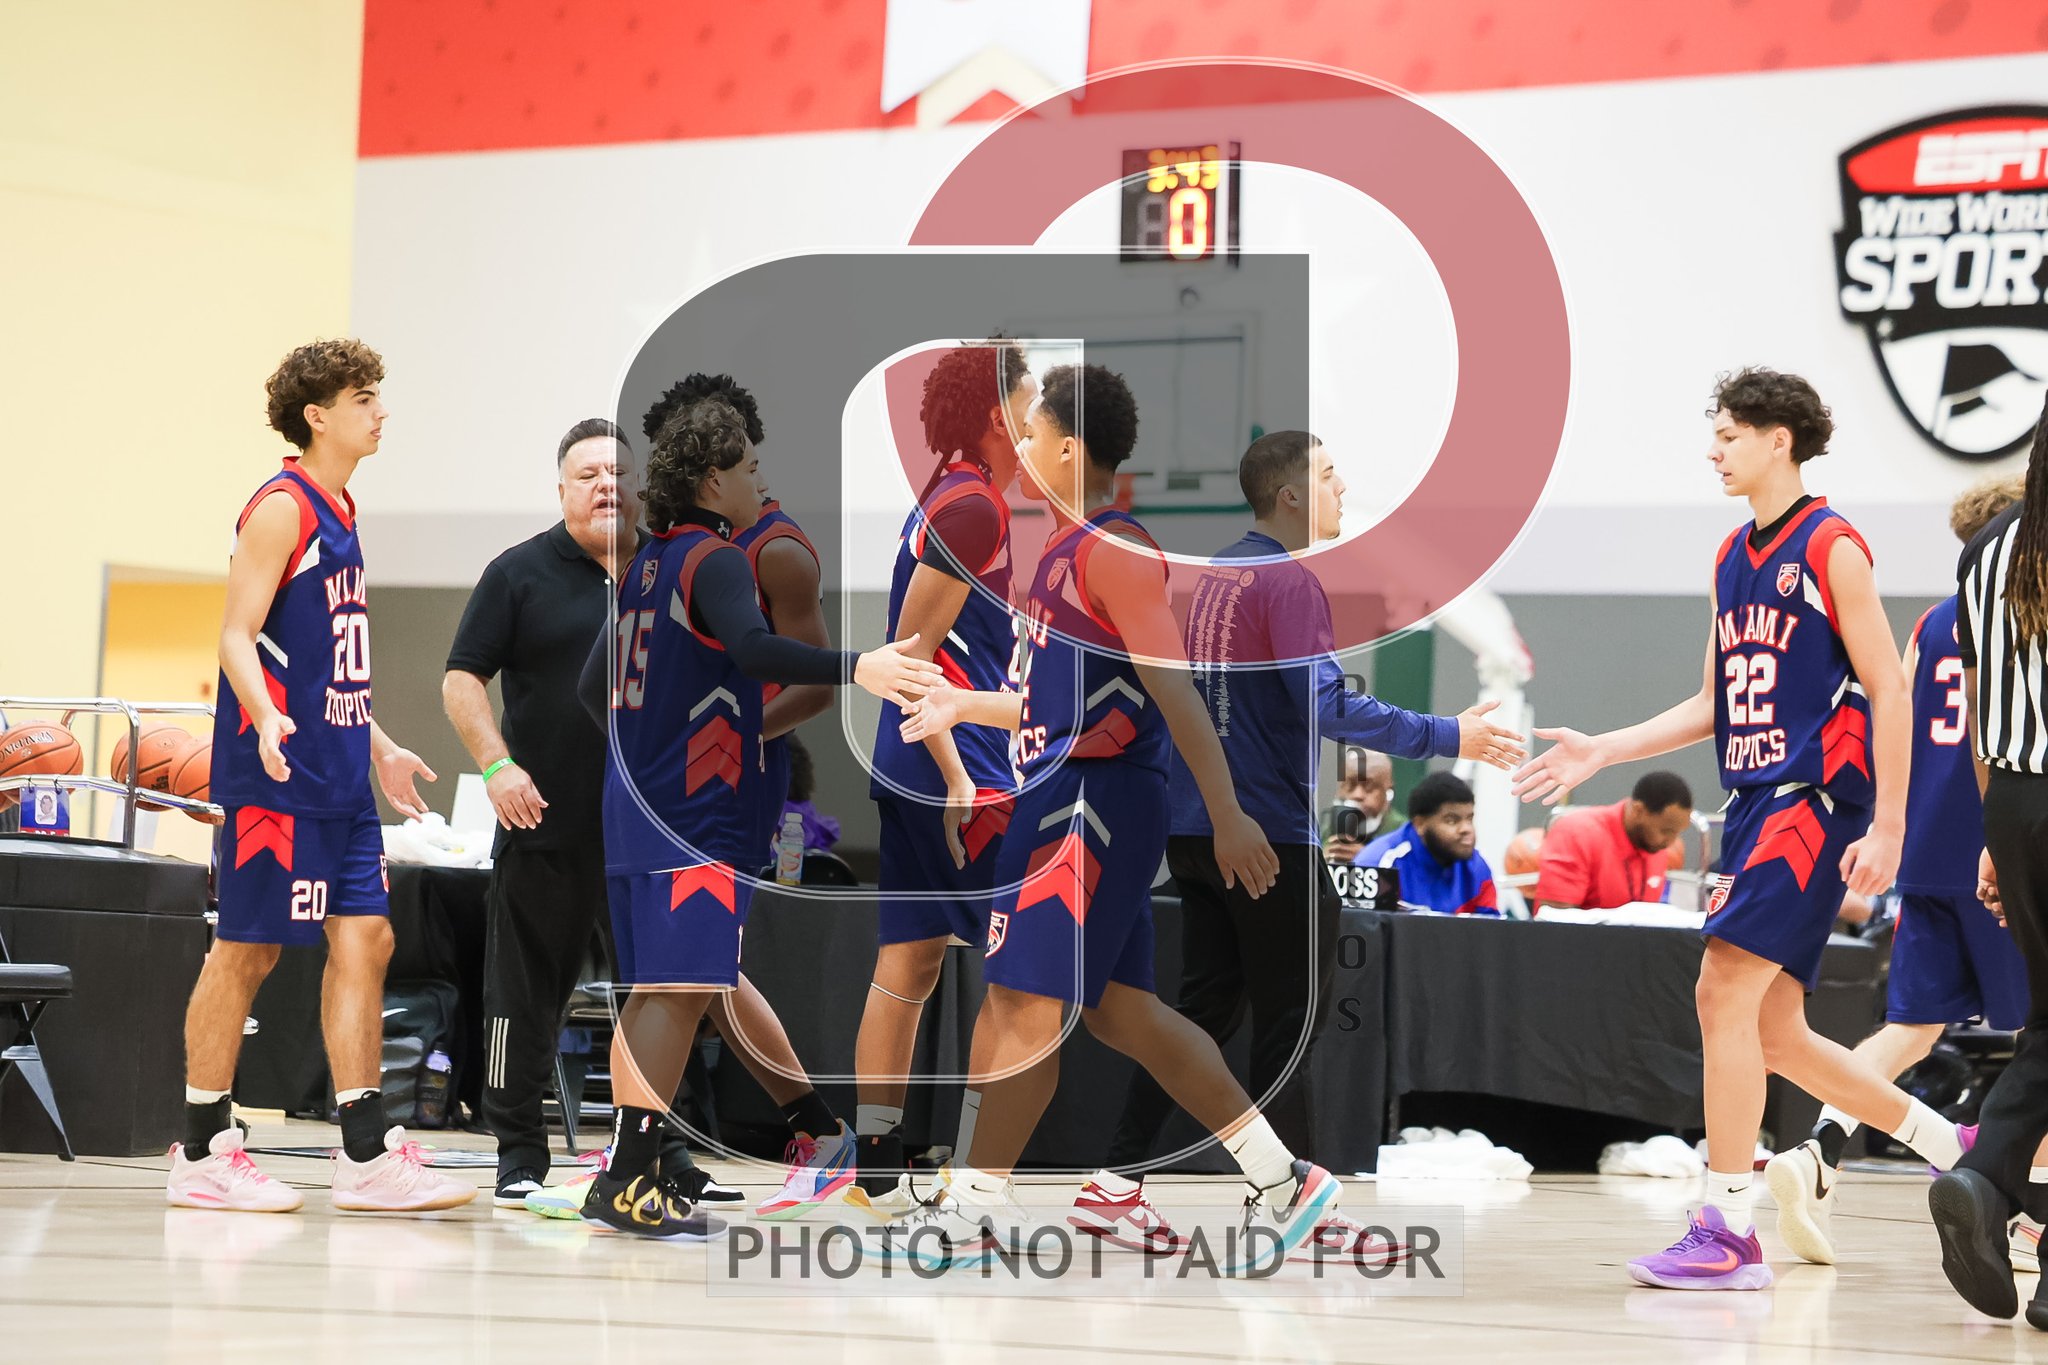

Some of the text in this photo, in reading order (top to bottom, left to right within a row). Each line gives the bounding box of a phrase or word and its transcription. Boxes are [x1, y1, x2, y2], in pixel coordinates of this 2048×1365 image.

[1168, 187, 1208, 260] 0
[1858, 194, 1956, 238] WIDE
[1840, 230, 2048, 313] SPOR
[332, 611, 371, 683] 20
[610, 608, 656, 711] 15
[1717, 603, 1800, 654] MAMI
[1724, 651, 1779, 727] 22
[291, 879, 328, 921] 20
[1328, 864, 1379, 899] OSS
